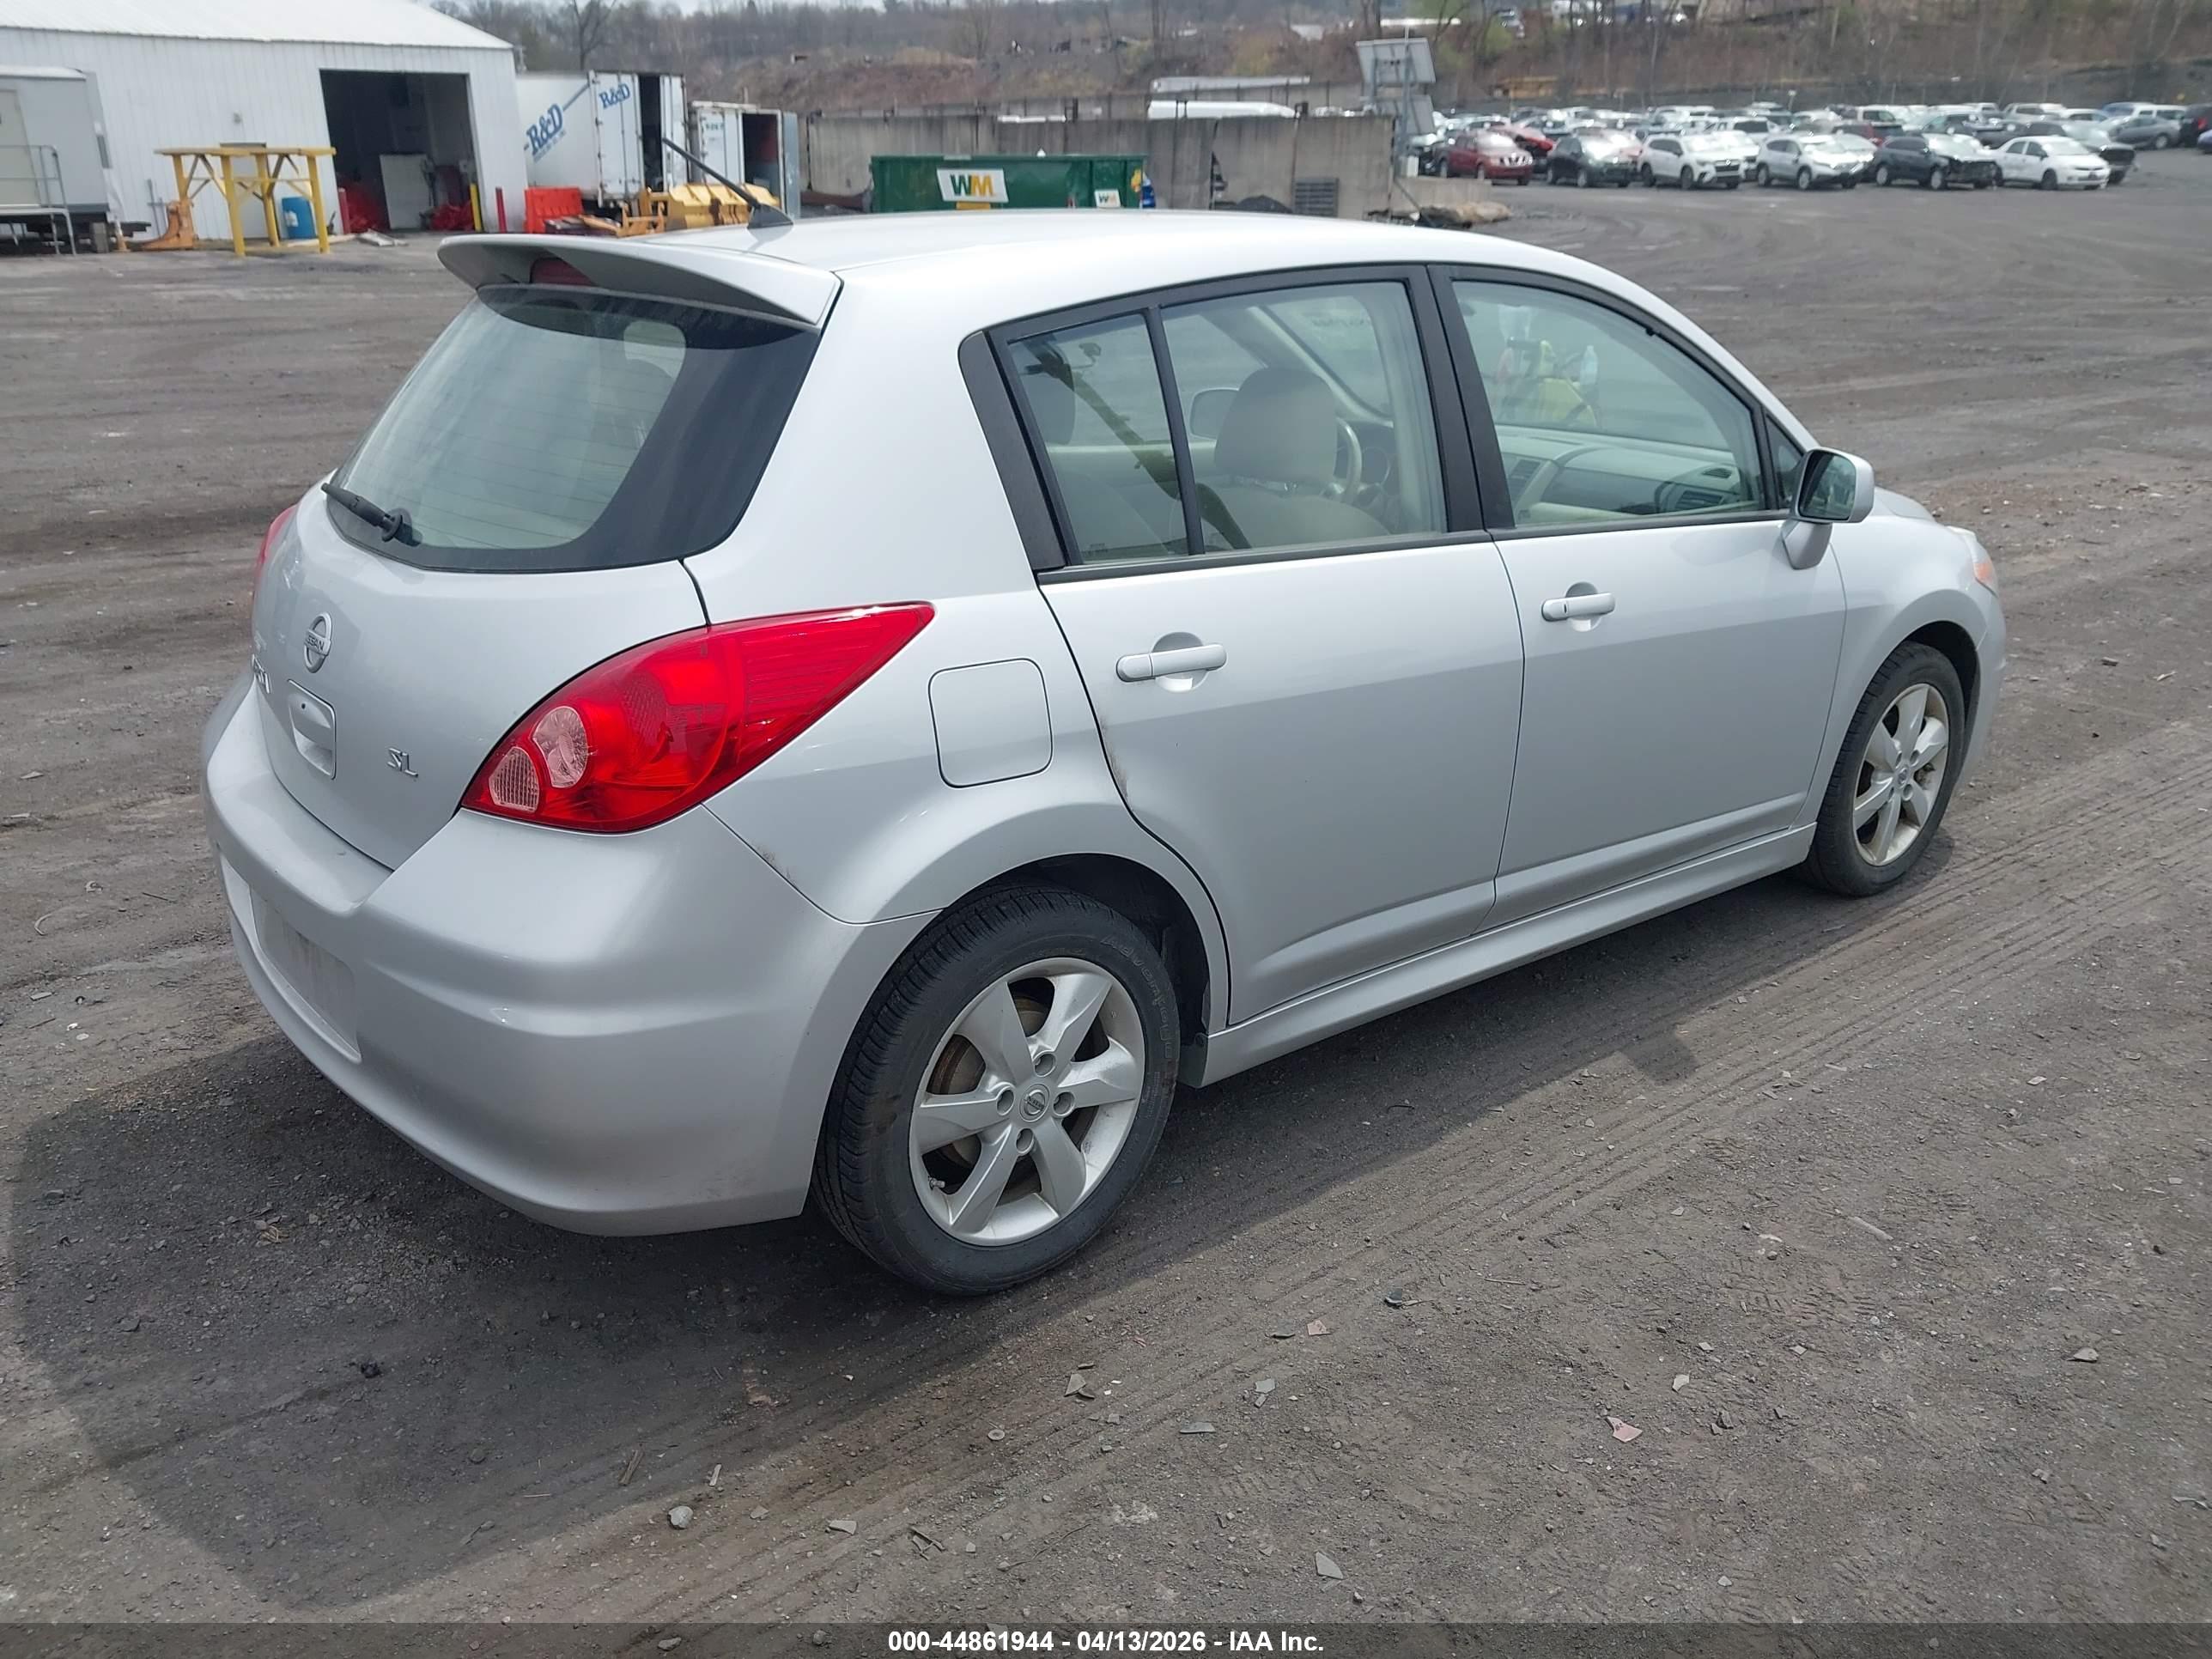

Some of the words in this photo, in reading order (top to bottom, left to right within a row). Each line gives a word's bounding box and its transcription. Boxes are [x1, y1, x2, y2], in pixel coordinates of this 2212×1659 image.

[599, 83, 630, 109] R&D
[526, 104, 563, 155] R&D
[950, 174, 994, 196] WM
[386, 746, 419, 778] SL
